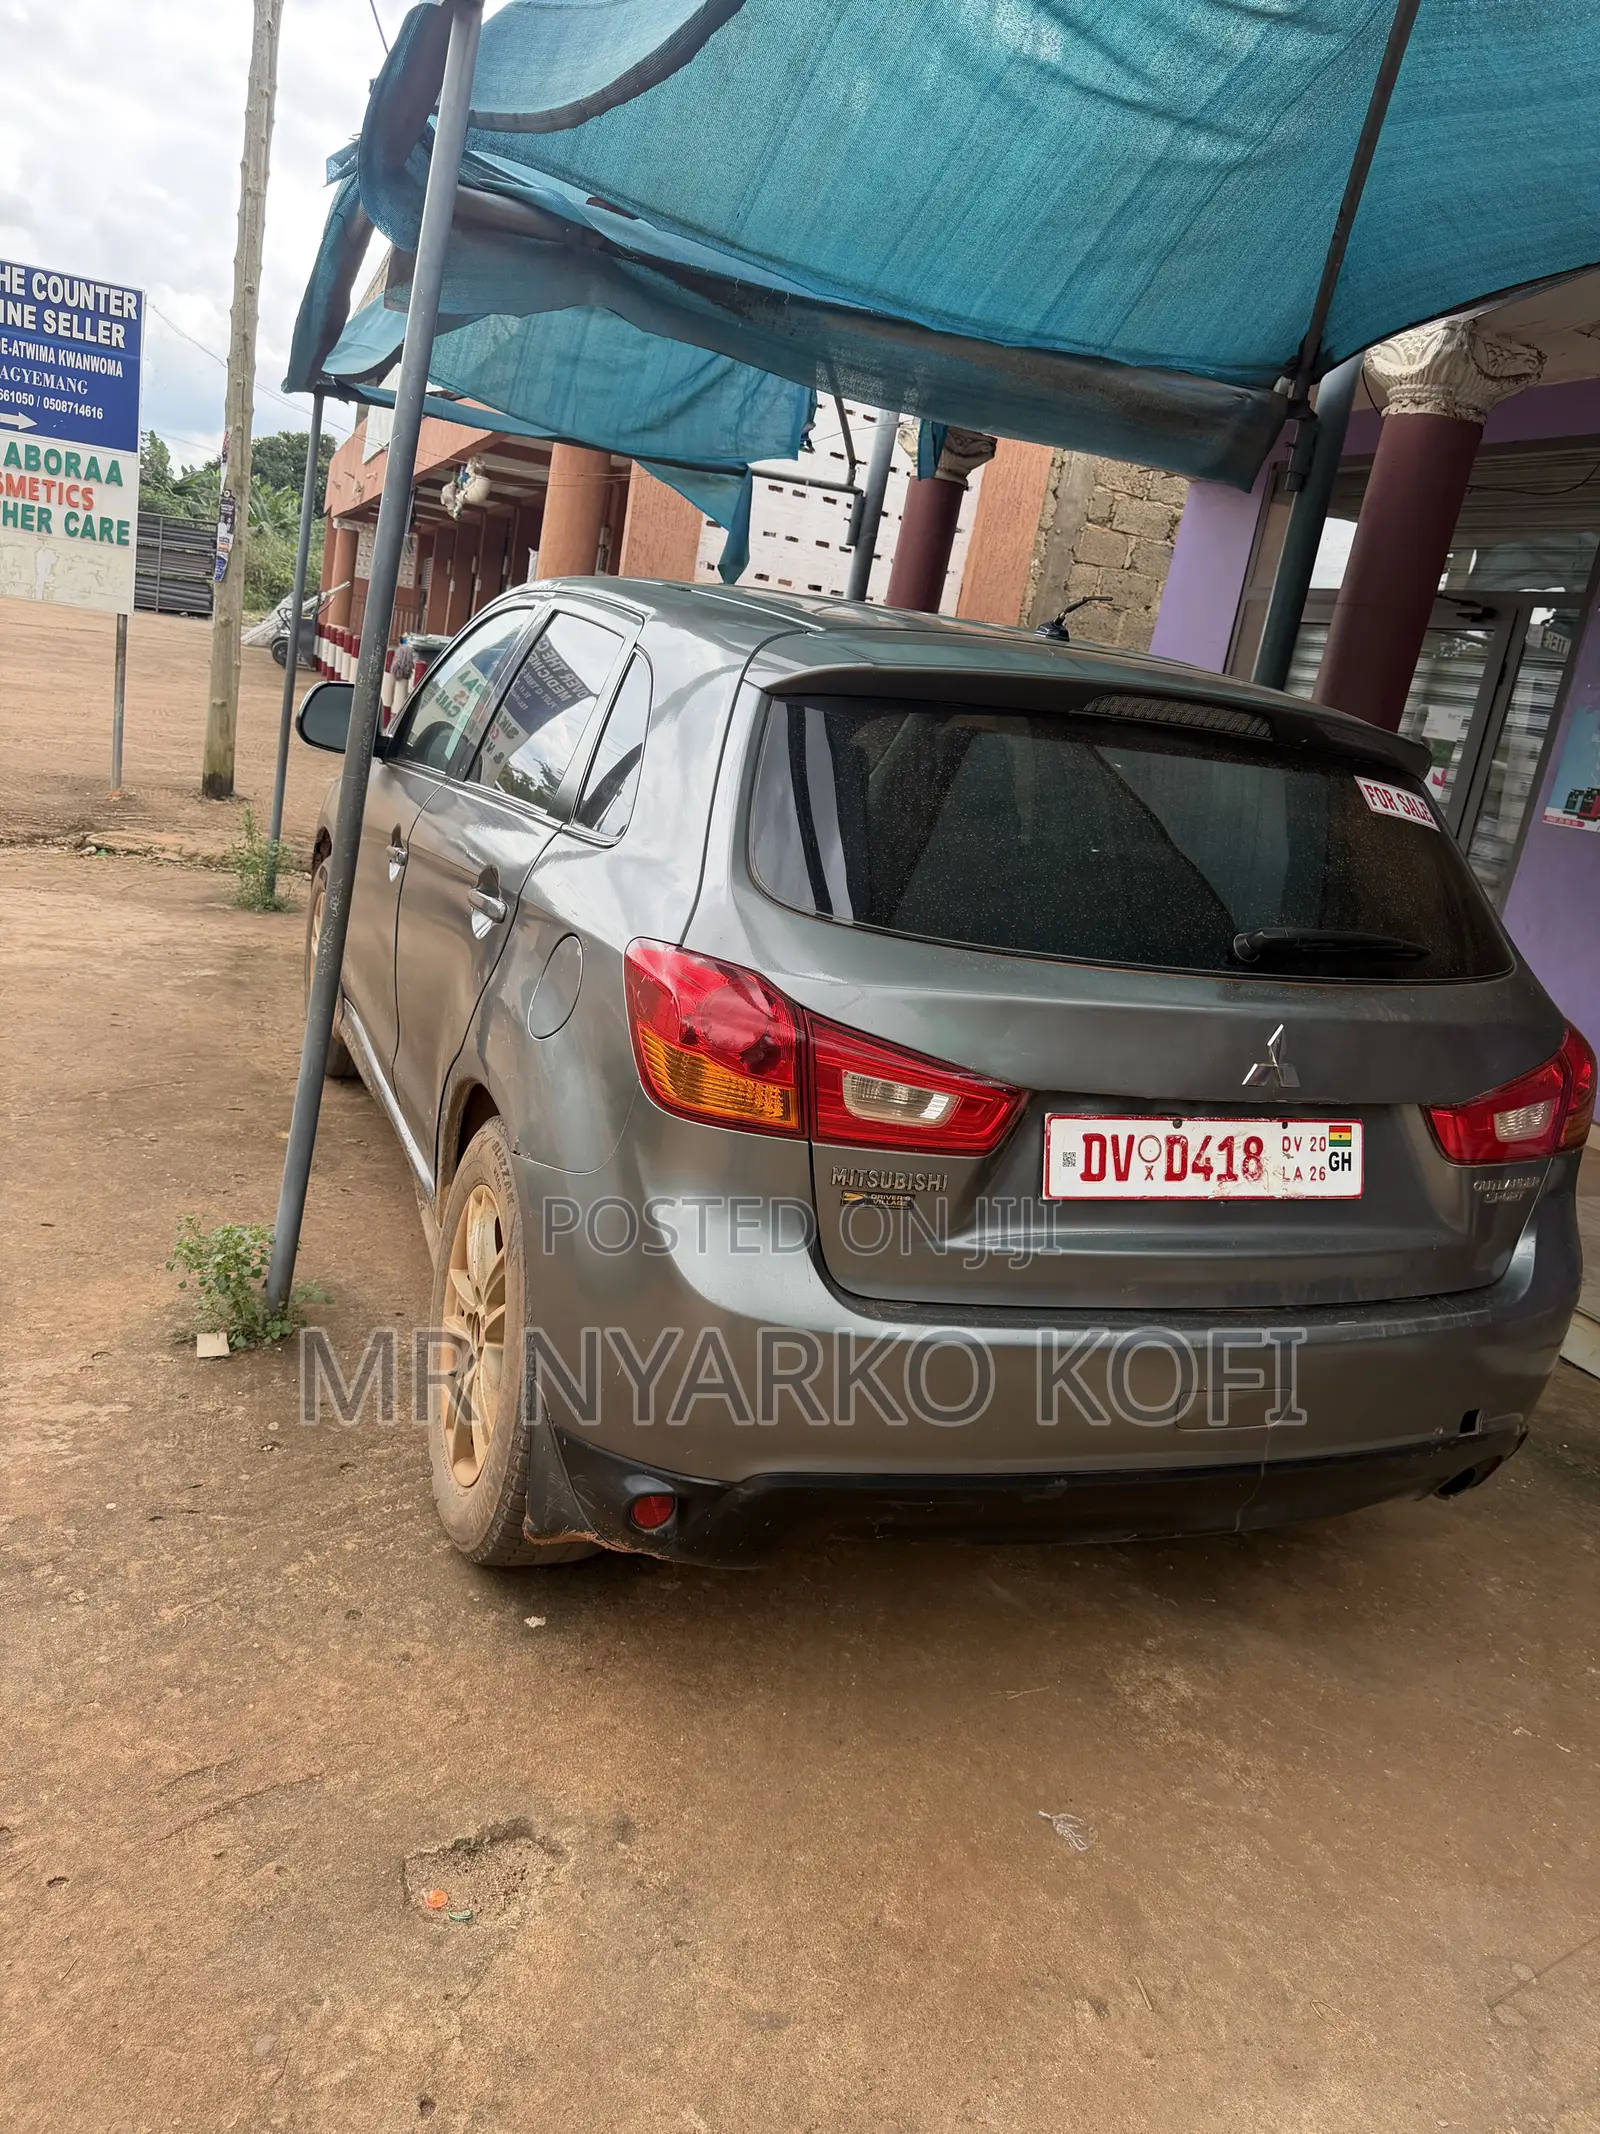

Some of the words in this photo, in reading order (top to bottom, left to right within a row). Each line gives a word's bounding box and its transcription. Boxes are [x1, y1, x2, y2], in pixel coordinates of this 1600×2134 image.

[32, 272, 138, 320] COUNTER
[43, 309, 126, 349] SELLER
[58, 349, 124, 378] KWANWOMA
[0, 364, 89, 395] AGYEMANG
[43, 396, 104, 420] 0508714616
[3, 441, 123, 487] ABORAA
[2, 500, 52, 534] HER
[64, 511, 130, 546] CARE
[1363, 784, 1399, 812] FOR
[1396, 792, 1434, 824] SALE
[1080, 1133, 1135, 1182] DV
[1164, 1134, 1265, 1182] D418
[1282, 1136, 1303, 1152] DV
[1310, 1136, 1327, 1152] 20
[1282, 1166, 1303, 1181] LA
[1310, 1166, 1327, 1181] 26
[1329, 1151, 1352, 1172] GH
[831, 1166, 949, 1192] MITSUBISHI
